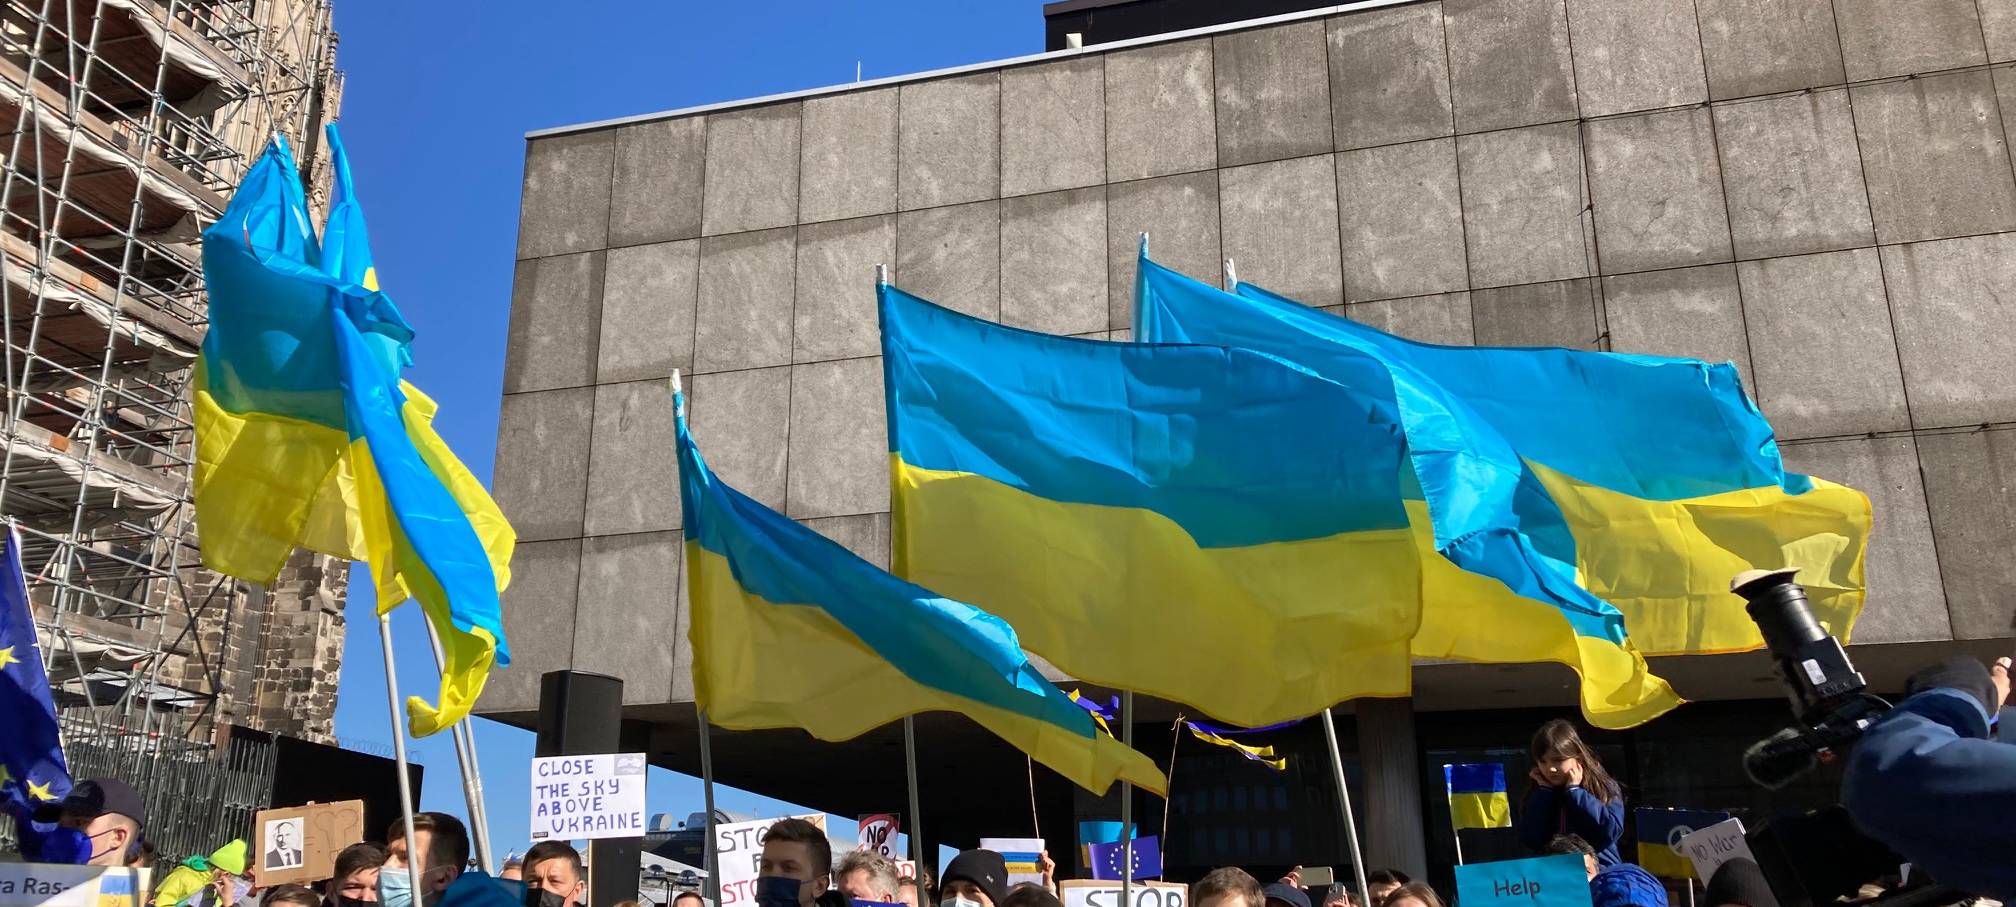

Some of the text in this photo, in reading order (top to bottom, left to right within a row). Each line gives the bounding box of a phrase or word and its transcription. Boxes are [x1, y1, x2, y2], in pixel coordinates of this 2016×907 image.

[538, 759, 594, 777] CLOSE
[536, 778, 619, 799] THE SKY
[537, 797, 603, 817] ABOVE
[552, 812, 641, 833] UKRAINE
[716, 826, 770, 853] STO
[867, 826, 888, 844] NO
[1493, 877, 1541, 899] Help
